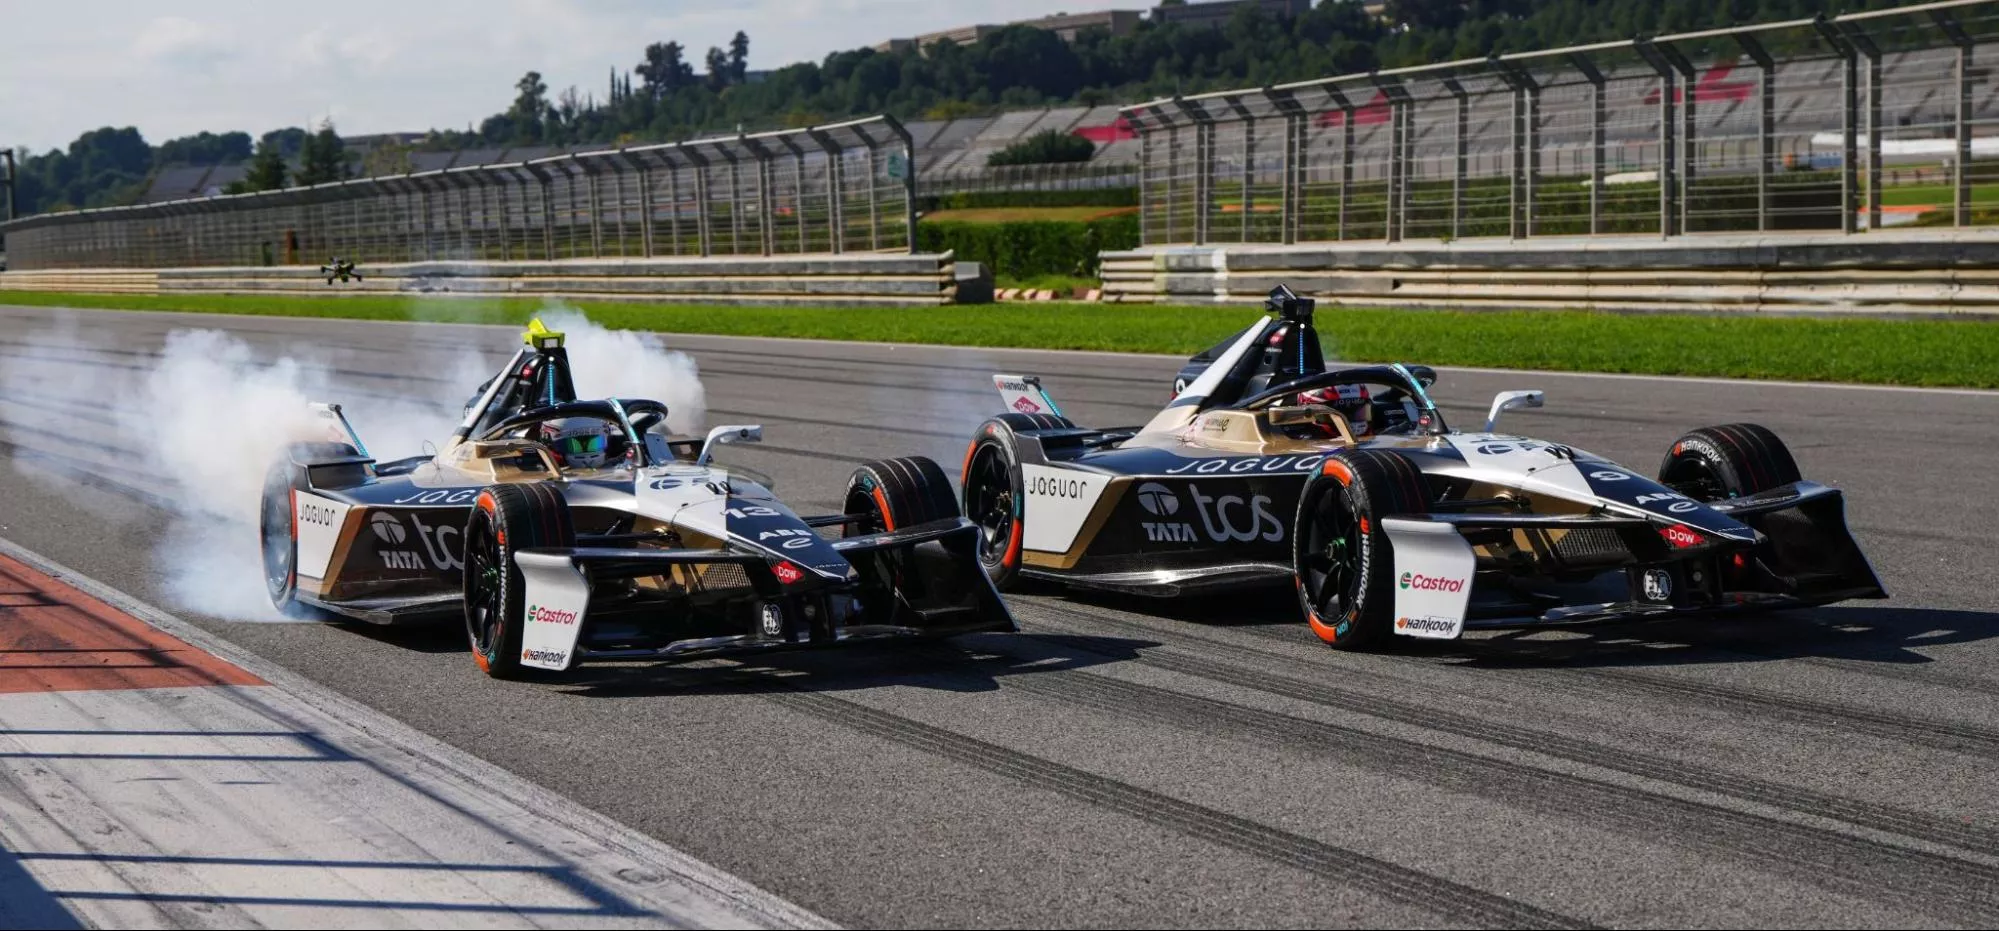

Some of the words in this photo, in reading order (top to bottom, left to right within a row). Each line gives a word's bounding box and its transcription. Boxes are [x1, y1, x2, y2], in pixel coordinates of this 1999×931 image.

[1166, 455, 1324, 474] JaGUa
[394, 489, 478, 504] JaG
[1189, 483, 1284, 542] tcs
[1142, 523, 1198, 541] TATA
[1668, 529, 1695, 543] Dow
[411, 513, 464, 570] tc
[379, 551, 426, 570] TATA
[778, 567, 797, 579] Dow
[1412, 574, 1465, 593] Castrol
[536, 607, 578, 625] Castrol
[1406, 618, 1456, 634] Hankook
[529, 650, 566, 664] Hankook
